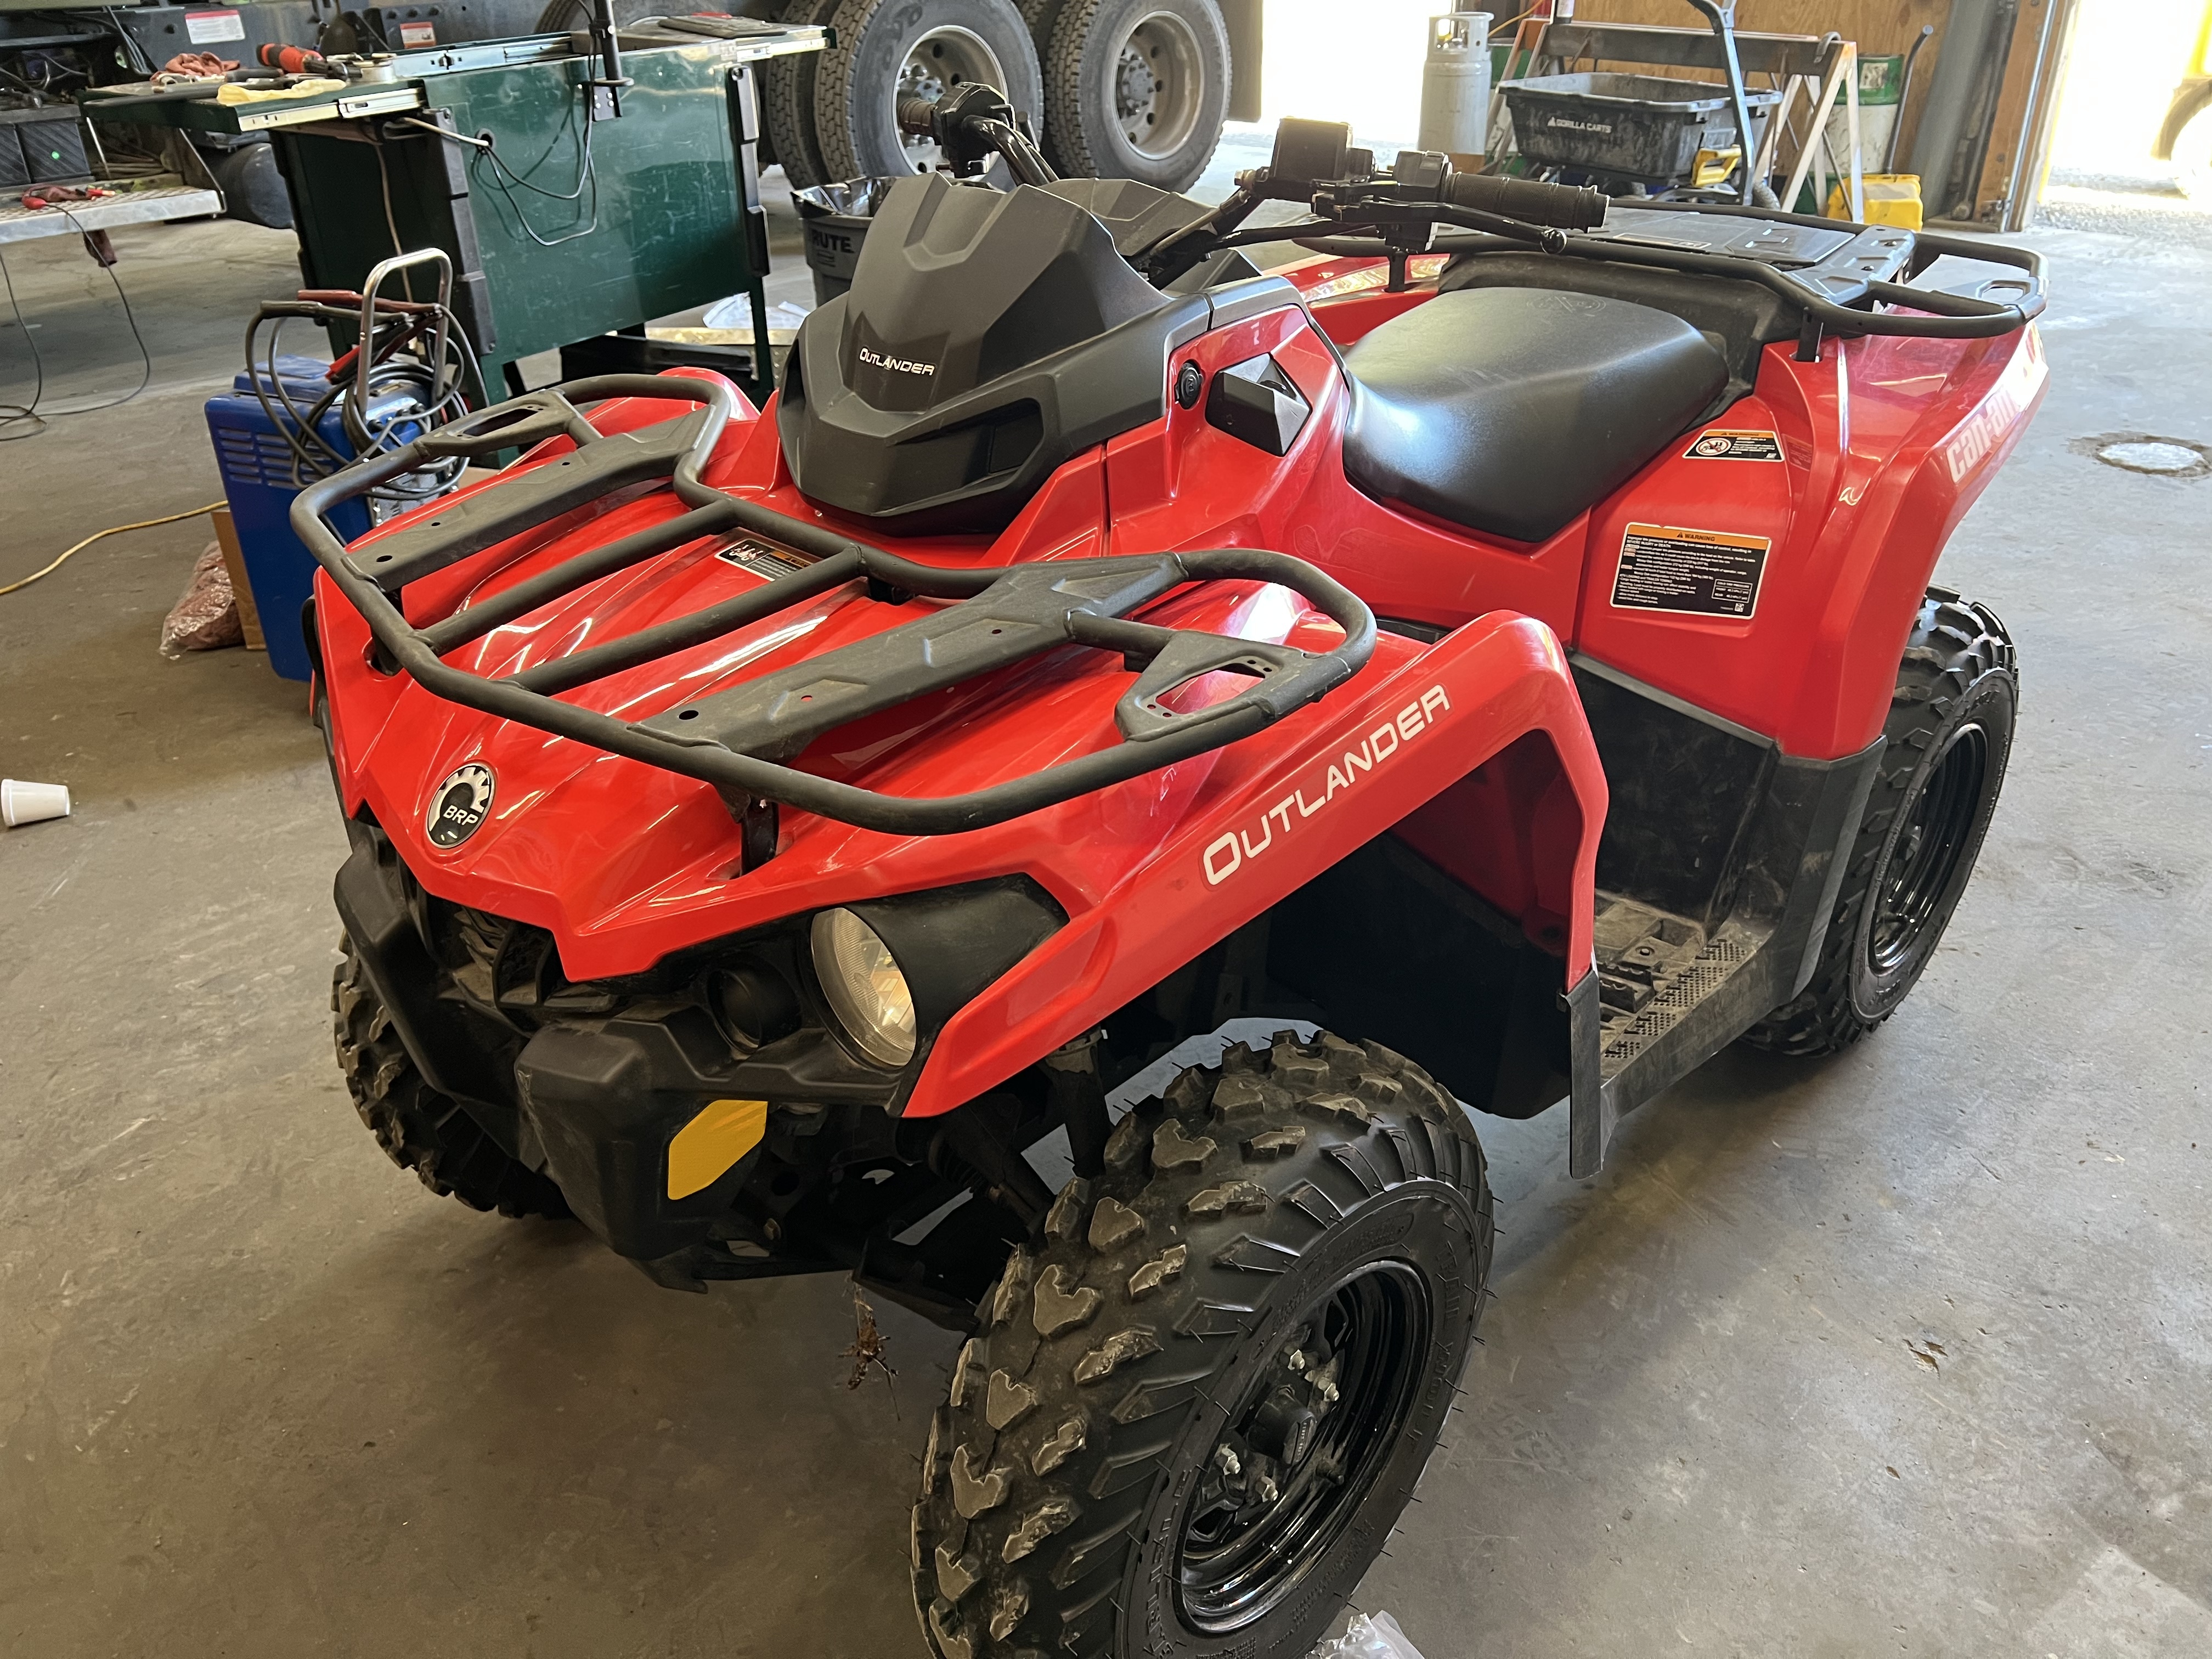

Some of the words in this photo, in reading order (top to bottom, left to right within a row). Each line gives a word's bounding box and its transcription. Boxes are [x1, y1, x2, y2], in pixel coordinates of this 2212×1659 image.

[810, 228, 855, 254] RUTE
[860, 348, 935, 376] OUTLANDER
[1204, 685, 1450, 885] OUTLANDER
[443, 805, 478, 826] BRP
